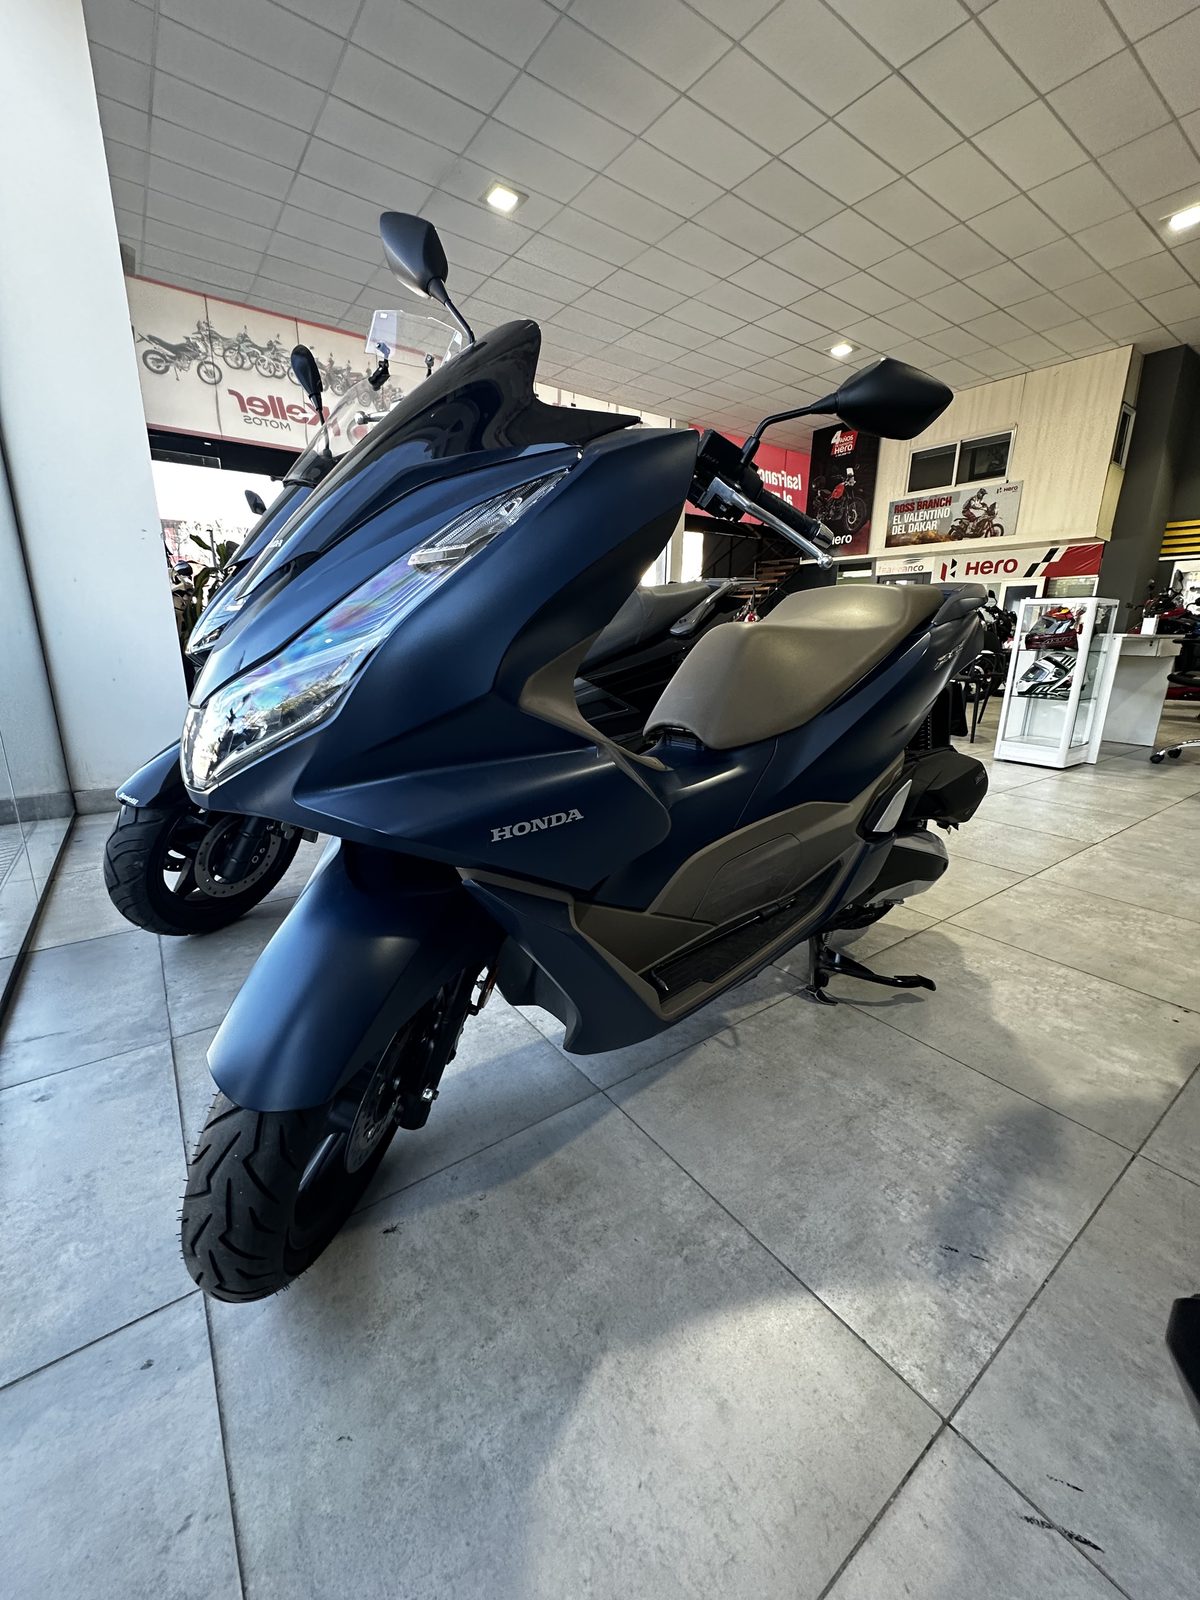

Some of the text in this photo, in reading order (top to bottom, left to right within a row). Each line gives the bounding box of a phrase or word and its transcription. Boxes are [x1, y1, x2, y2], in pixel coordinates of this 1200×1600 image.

[831, 430, 842, 445] 4
[834, 443, 853, 455] Hero
[894, 496, 953, 514] ROSS BRANCH
[892, 507, 951, 525] EL VALENTINO
[891, 520, 938, 536] DEL DAKAR
[965, 558, 1019, 575] Hero
[490, 808, 585, 842] HONDA
